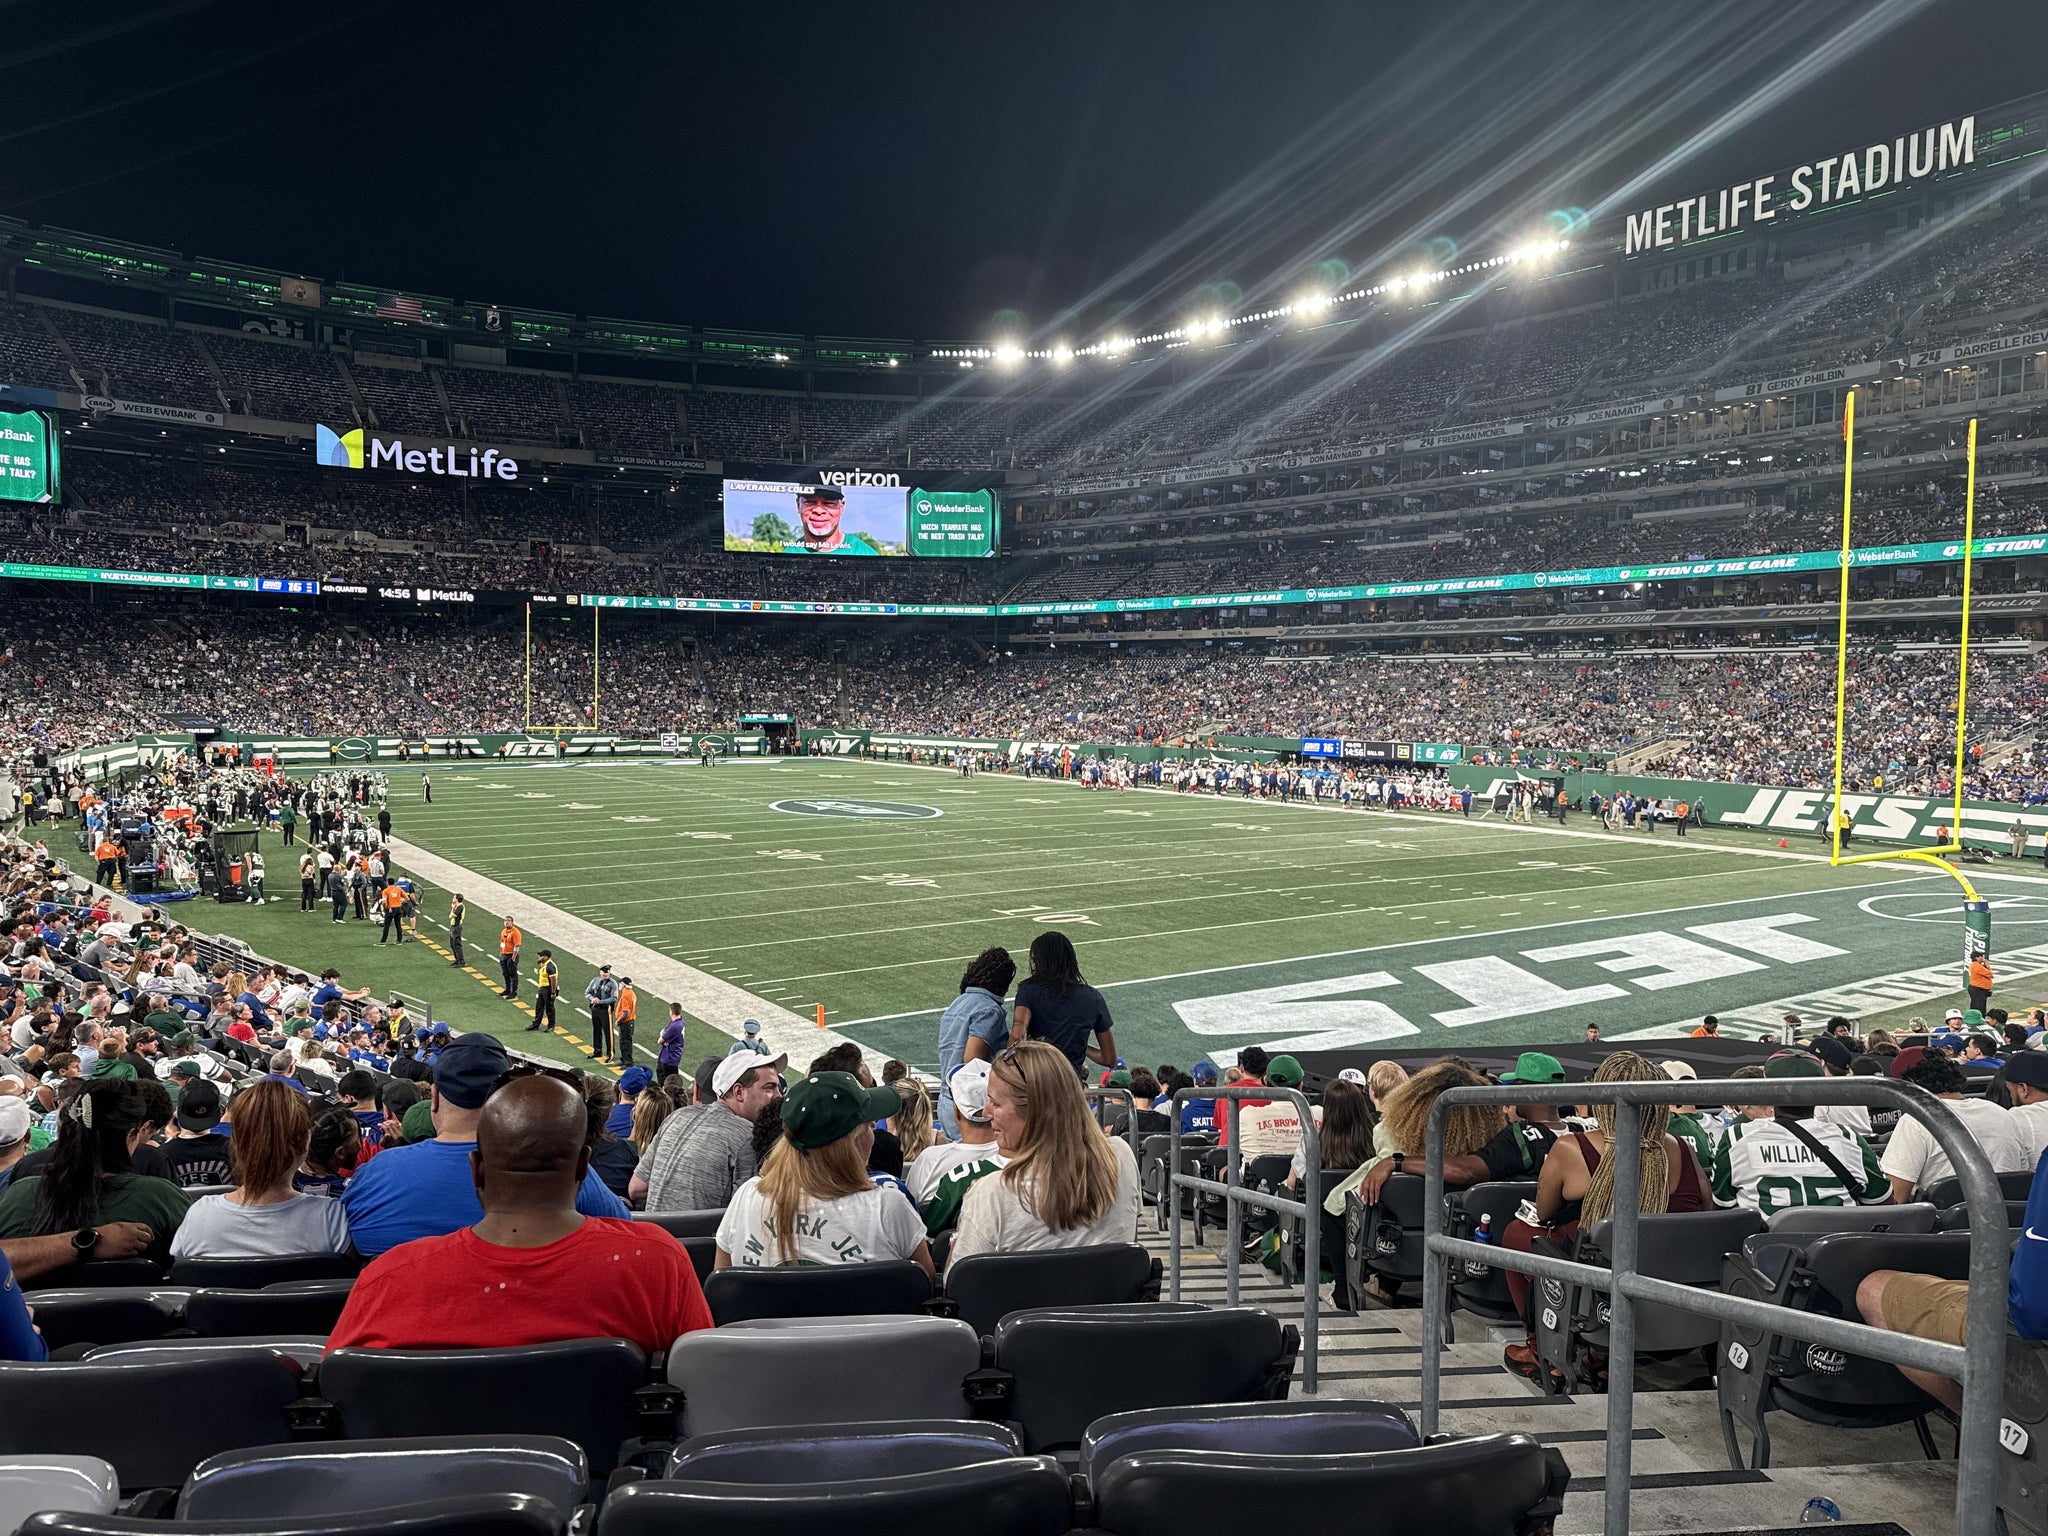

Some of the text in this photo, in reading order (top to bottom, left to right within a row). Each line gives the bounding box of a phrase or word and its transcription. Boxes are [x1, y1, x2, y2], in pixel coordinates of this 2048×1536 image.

[1625, 116, 1976, 255] METLIFE STADIUM
[1919, 330, 2048, 365] 24 DARRELLE REV
[1745, 368, 1845, 395] 81 GERRY PHILBIN
[88, 400, 113, 408] COACH
[122, 403, 197, 420] WEEB EWBANK
[1556, 404, 1645, 426] 12 JOE NAMATH
[1419, 427, 1507, 448] 24 FREEMAN MCNEIL
[13, 456, 31, 467] HAS
[371, 438, 519, 481] MetLife
[613, 456, 635, 464] SUPER
[636, 458, 657, 466] BOWL
[665, 460, 705, 469] CHAMPIONS
[1309, 454, 1325, 463] DON
[1325, 450, 1362, 461] MAYNARD
[9, 467, 36, 479] TALK?
[819, 467, 900, 487] verizon
[730, 483, 815, 494] LAVERANUES COLES
[934, 504, 985, 513] WebsterBank
[920, 523, 939, 531] WHICH
[941, 523, 969, 531] TEAMMATE
[918, 532, 928, 540] THE
[968, 533, 985, 541] TALK?
[1857, 549, 1919, 564] WebsterBank
[1619, 558, 1798, 579] QUESTION OF THE GAME
[1548, 573, 1591, 583] WebsterBank
[335, 586, 368, 594] QUARTER
[379, 588, 410, 598] 14:56
[1317, 588, 1353, 598] WebsterBank
[1366, 579, 1505, 596] QUESTION OF THE GAME
[433, 590, 474, 602] MetLife
[1173, 597, 1217, 607] QUESTION
[1233, 595, 1251, 603] THE
[1252, 593, 1284, 601] GAME
[1001, 605, 1041, 614] QUESTION
[1977, 597, 2040, 609] MetLife
[1778, 606, 1830, 616] MetLife
[663, 735, 677, 746] 25
[492, 741, 556, 757] JETS
[1344, 748, 1363, 757] 14:56
[1426, 747, 1435, 759] 6
[1720, 789, 1930, 840] JETS
[991, 904, 1090, 924] 10
[1172, 912, 1852, 1068] JETS
[1274, 1118, 1299, 1128] BROW
[1759, 1145, 1823, 1164] WILLIAM
[742, 1233, 765, 1267] EW
[763, 1214, 828, 1240] YRK
[1545, 1311, 1554, 1326] 15
[1732, 1347, 1743, 1364] 16
[1813, 1359, 1845, 1372] MetLife
[2004, 1425, 2022, 1446] 17
